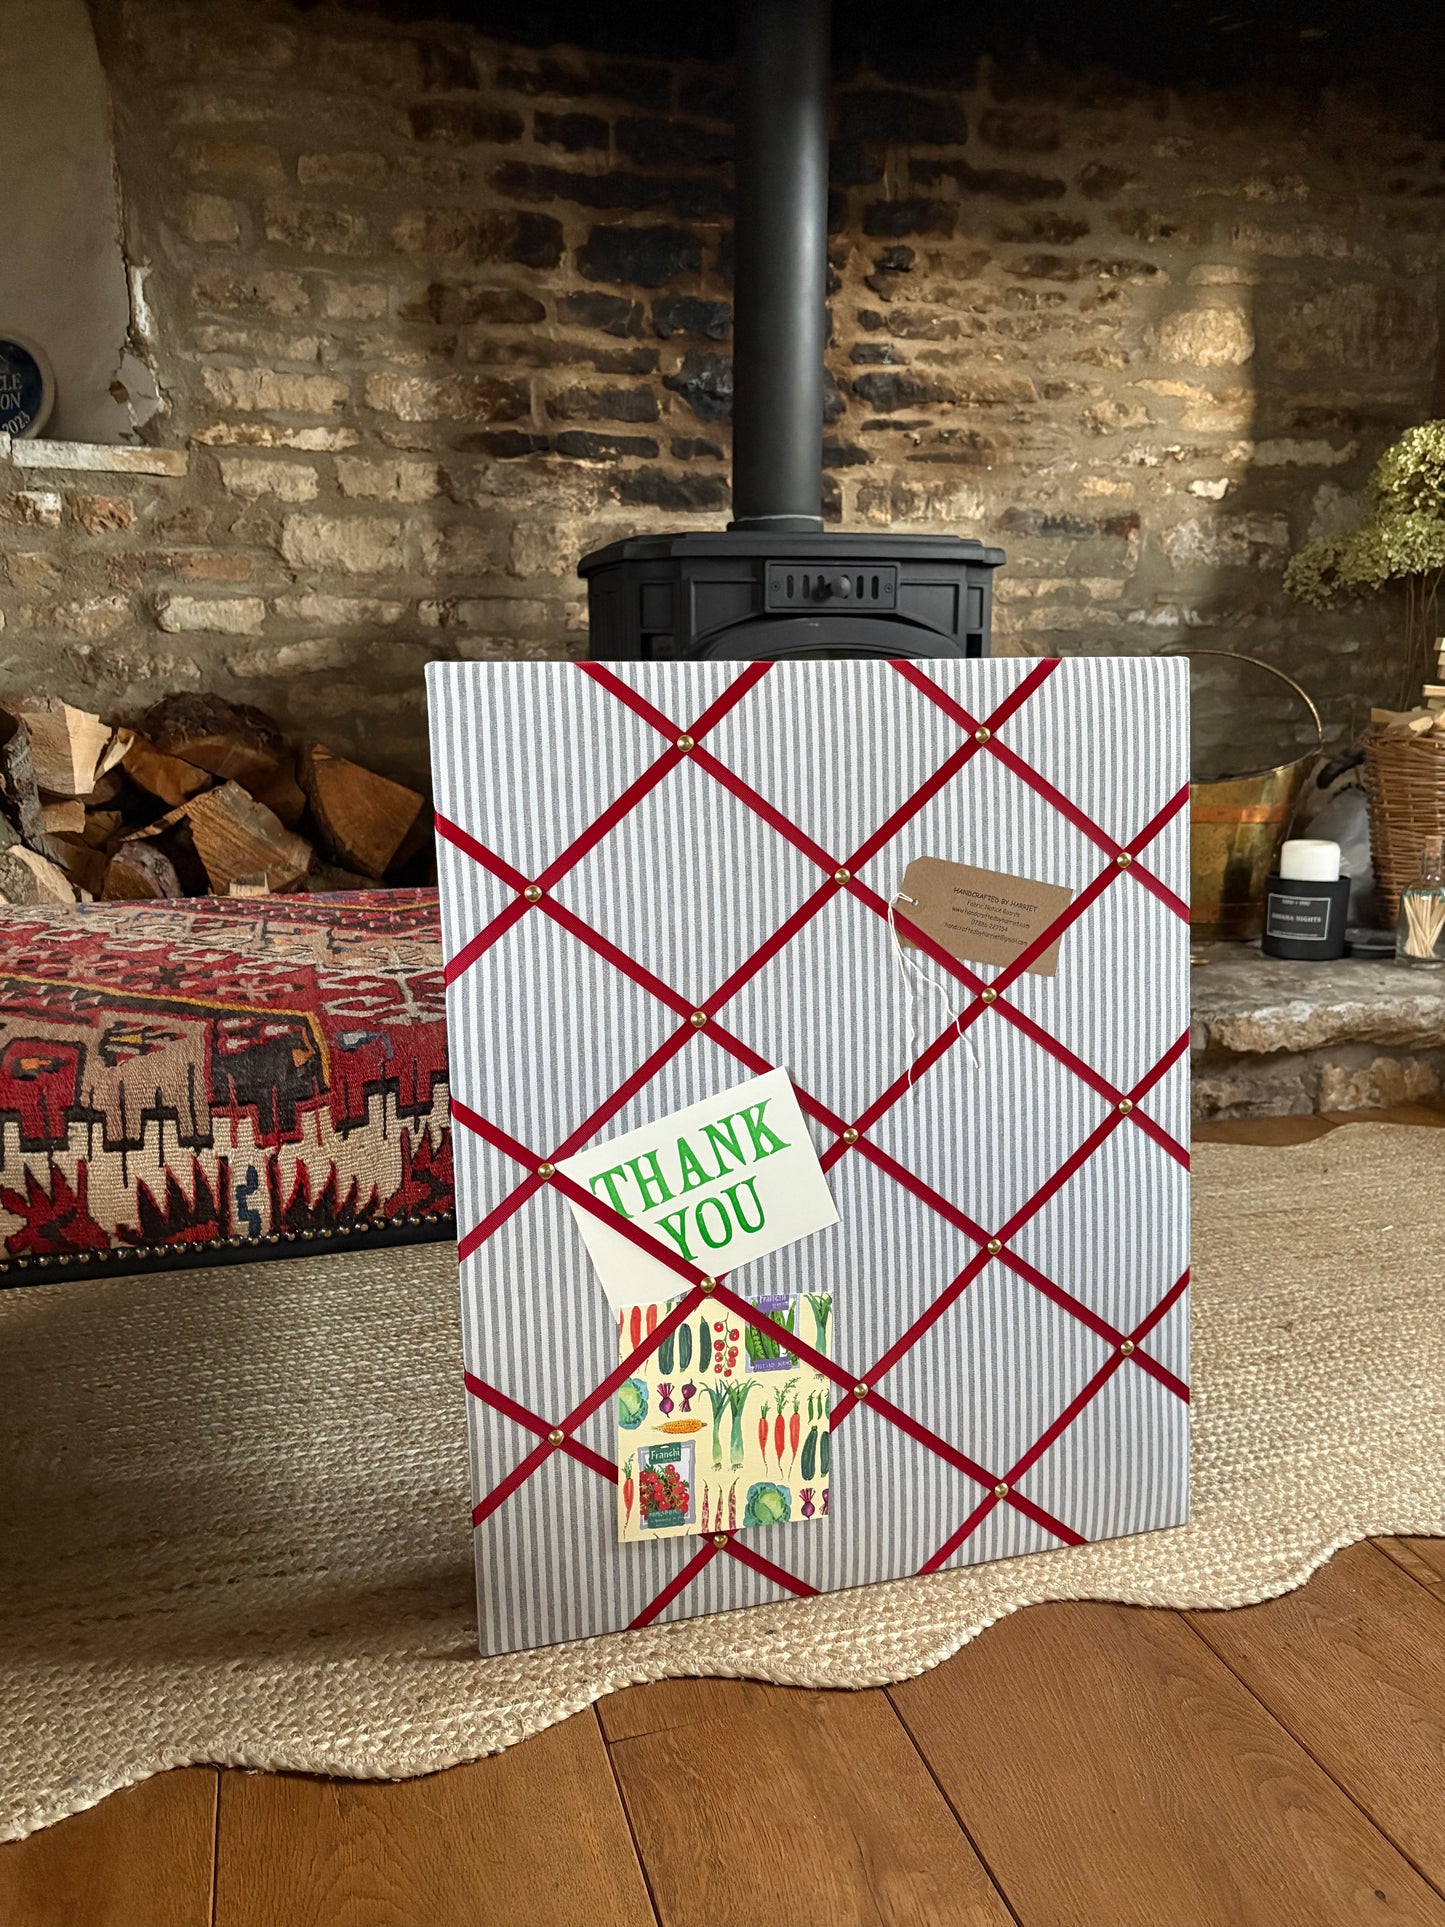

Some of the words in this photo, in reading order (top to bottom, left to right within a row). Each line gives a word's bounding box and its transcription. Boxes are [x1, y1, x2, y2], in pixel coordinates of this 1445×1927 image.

[953, 887, 999, 903] HANDCRAFTED
[1010, 900, 1038, 912] HARRIET
[966, 900, 983, 909] Fabric
[1295, 915, 1321, 923] NIGHTS
[588, 1098, 792, 1220] THANK
[654, 1175, 766, 1262] YOU
[651, 1447, 680, 1460] Franchi
